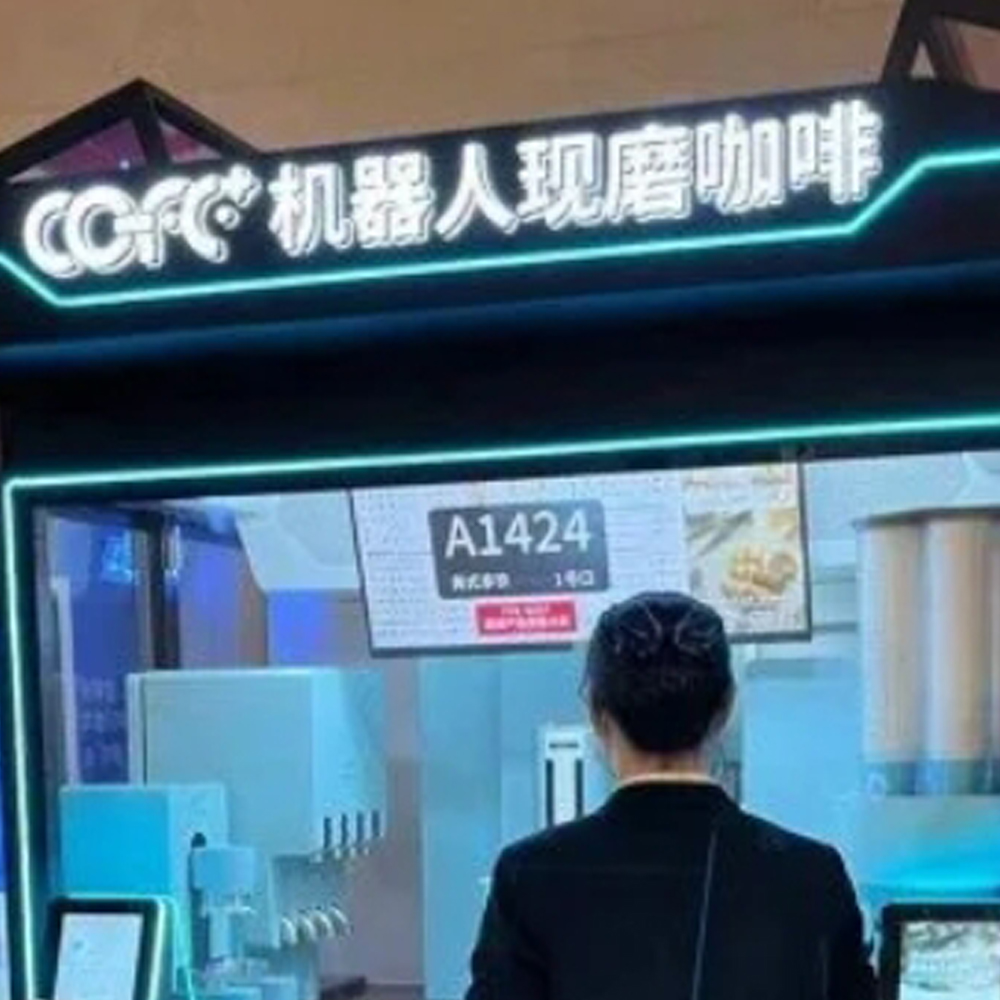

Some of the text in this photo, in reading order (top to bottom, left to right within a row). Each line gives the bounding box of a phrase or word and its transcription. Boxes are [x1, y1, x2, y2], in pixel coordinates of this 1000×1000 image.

[268, 99, 883, 258] 机器人现磨咖啡
[445, 509, 592, 559] A1424
